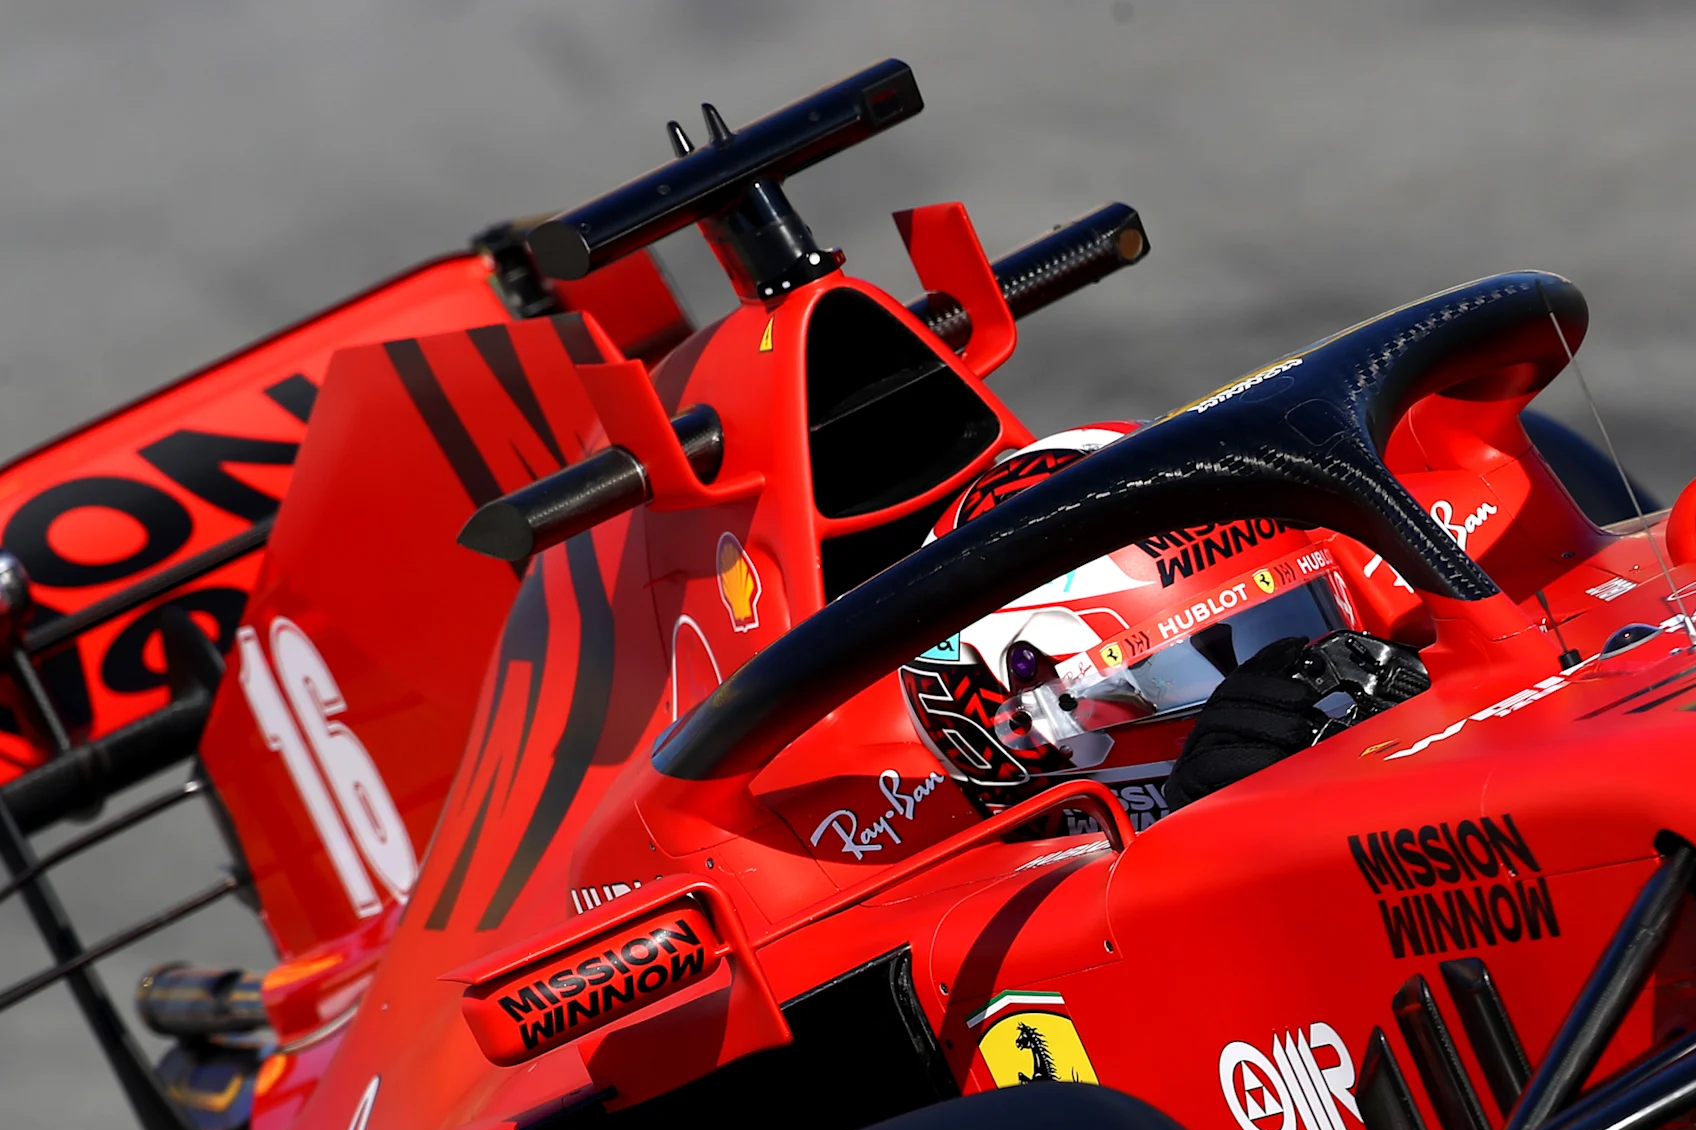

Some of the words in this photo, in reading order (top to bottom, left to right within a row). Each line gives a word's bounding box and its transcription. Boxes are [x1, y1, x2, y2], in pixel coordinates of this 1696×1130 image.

[1157, 582, 1249, 639] HUBLOT
[237, 616, 420, 919] 16
[1347, 814, 1541, 895] MISSION
[1378, 877, 1561, 959] WINNOW
[498, 919, 702, 1023] MISSION
[519, 946, 705, 1050] WINNOW
